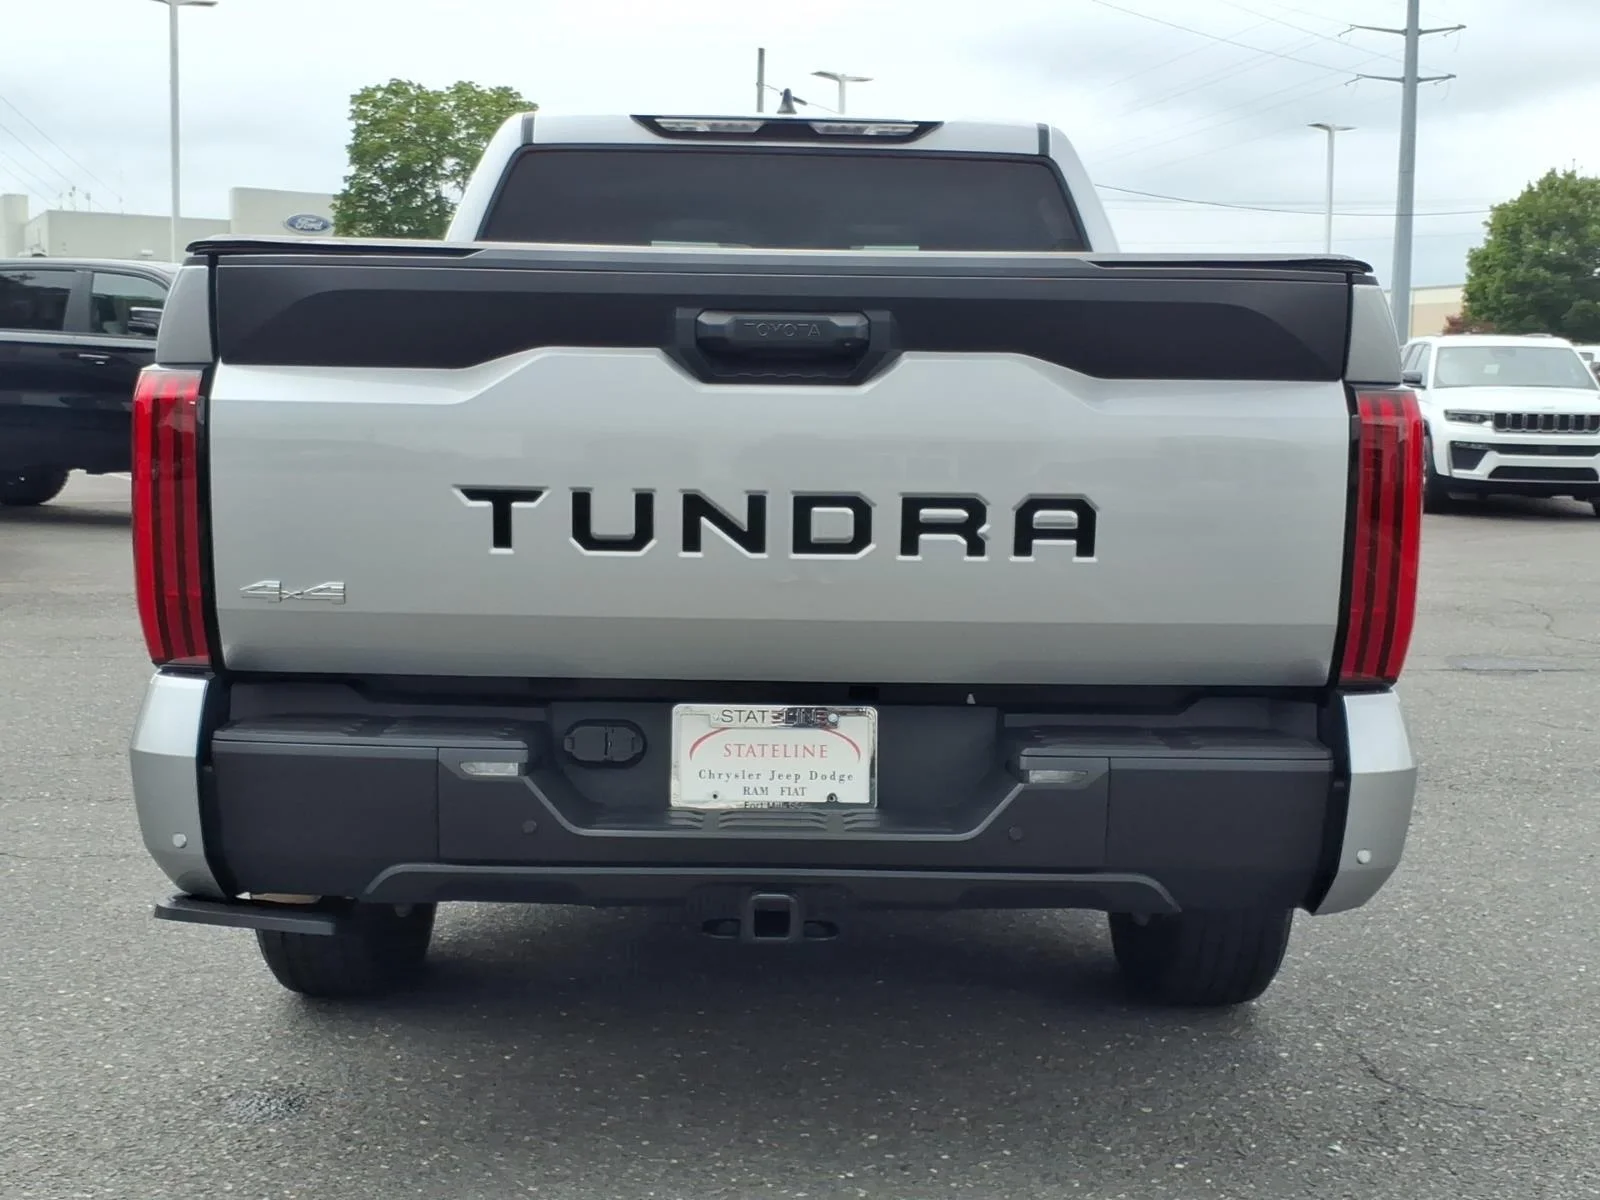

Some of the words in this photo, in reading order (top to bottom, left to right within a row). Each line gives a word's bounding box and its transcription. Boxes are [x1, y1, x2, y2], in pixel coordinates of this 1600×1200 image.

[294, 216, 323, 231] Ford
[743, 322, 821, 337] TOYOTA
[452, 484, 1100, 563] TUNDRA
[723, 743, 829, 759] STATELINE
[698, 769, 762, 782] Chrysler
[769, 769, 802, 784] Jeep
[809, 770, 854, 784] Dodge
[743, 786, 769, 796] RAM
[780, 786, 807, 796] FIAT
